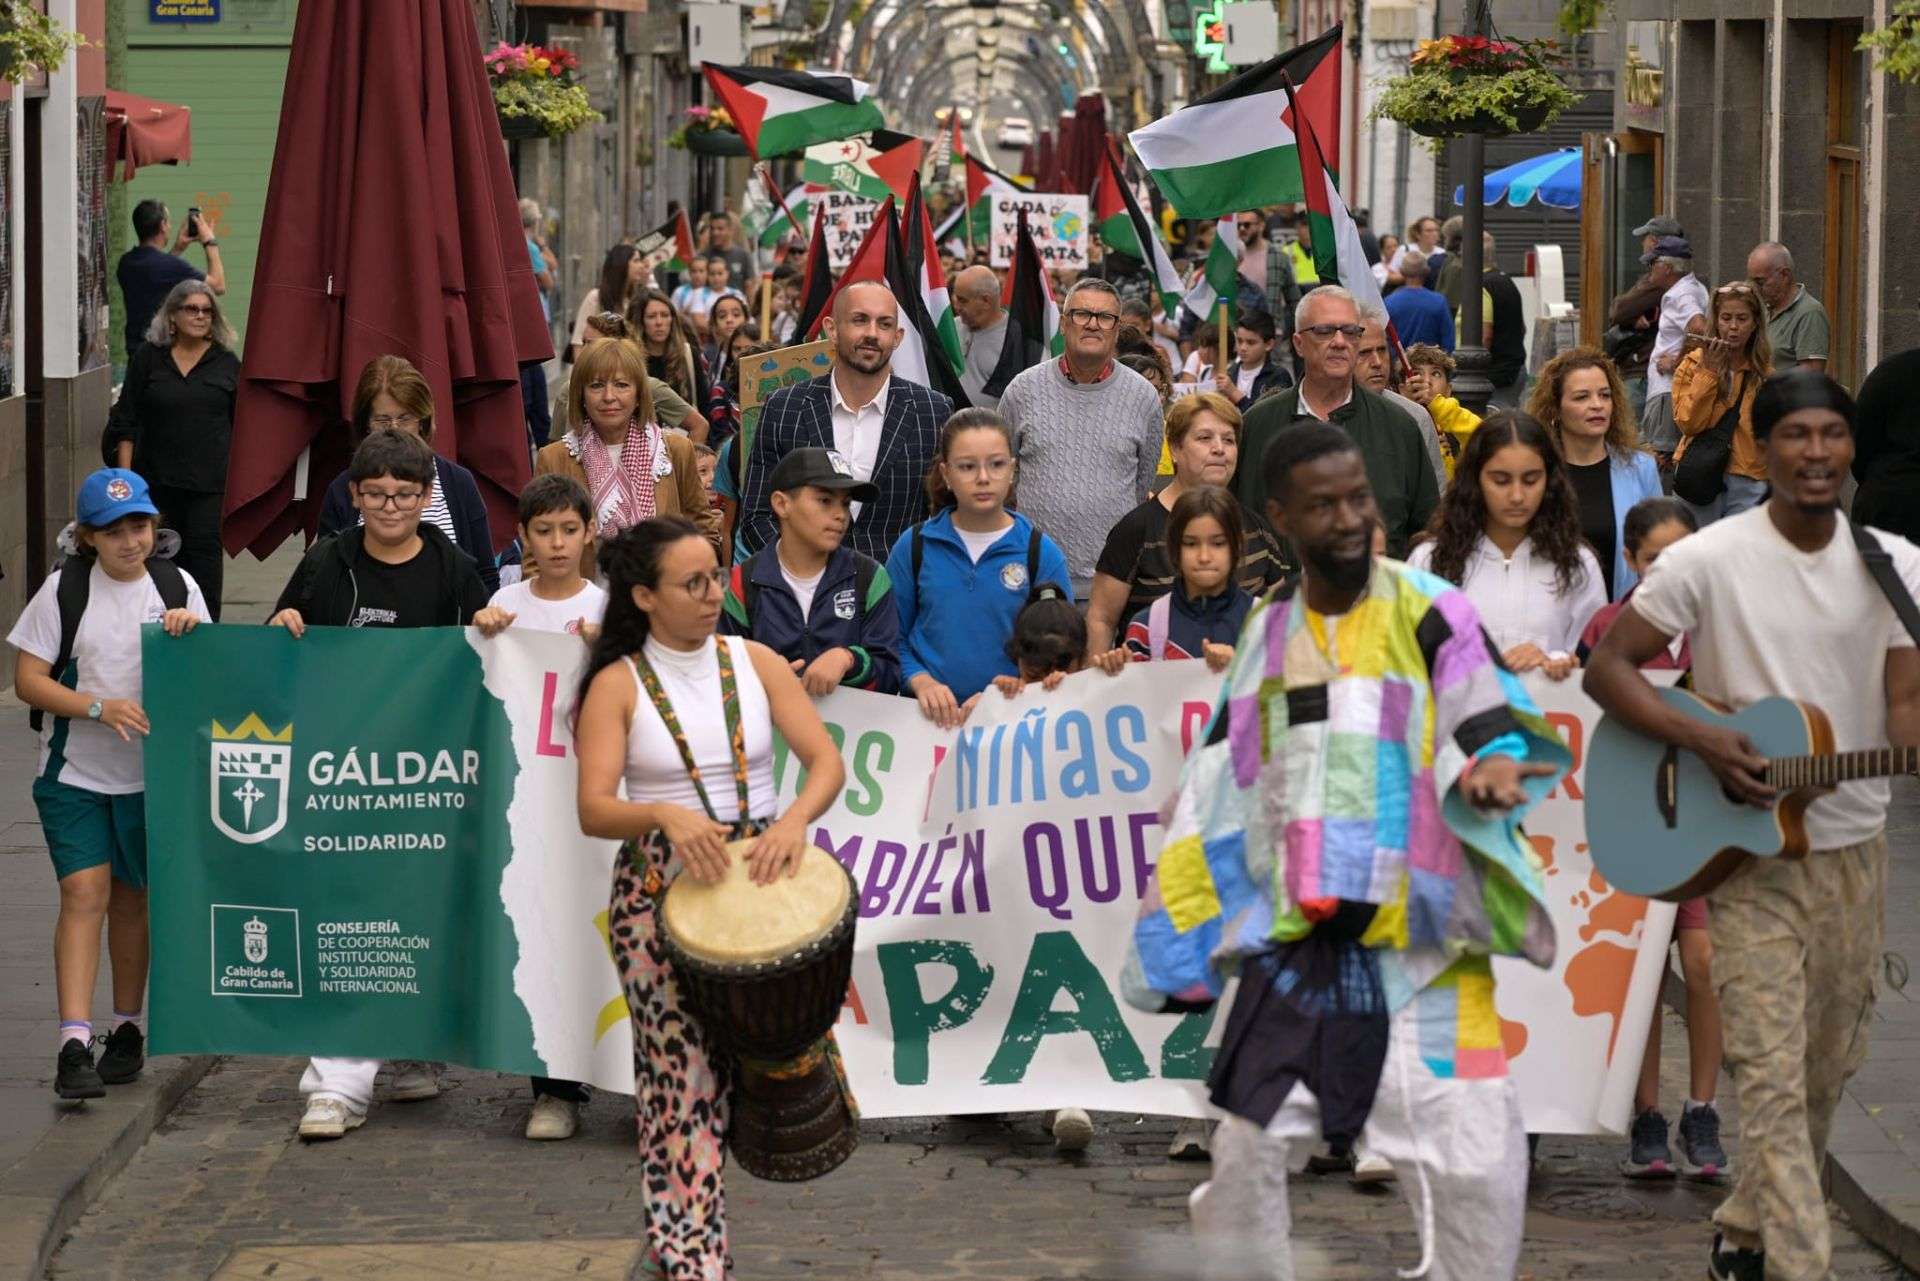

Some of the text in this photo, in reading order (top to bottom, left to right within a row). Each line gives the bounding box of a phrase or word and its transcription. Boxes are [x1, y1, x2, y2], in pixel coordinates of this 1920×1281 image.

[156, 5, 215, 16] Gran Canaria
[998, 201, 1045, 215] CADA
[1003, 223, 1044, 238] VDA
[308, 746, 480, 786] GÁLDAR
[305, 792, 465, 810] AYUNTAMIENTO
[304, 833, 446, 852] SOLIDARIDAD
[813, 822, 991, 919] MBIÉN
[317, 919, 400, 934] CONSEJERÍA
[318, 935, 430, 949] DE COOPERACIÓN
[318, 951, 414, 963] INSTITUCIONAL
[225, 966, 285, 978] Cabildo de
[319, 966, 416, 979] Y SOLIDARIDAD
[220, 976, 294, 990] Gran Canaria
[320, 980, 420, 994] INTERNACIONAL
